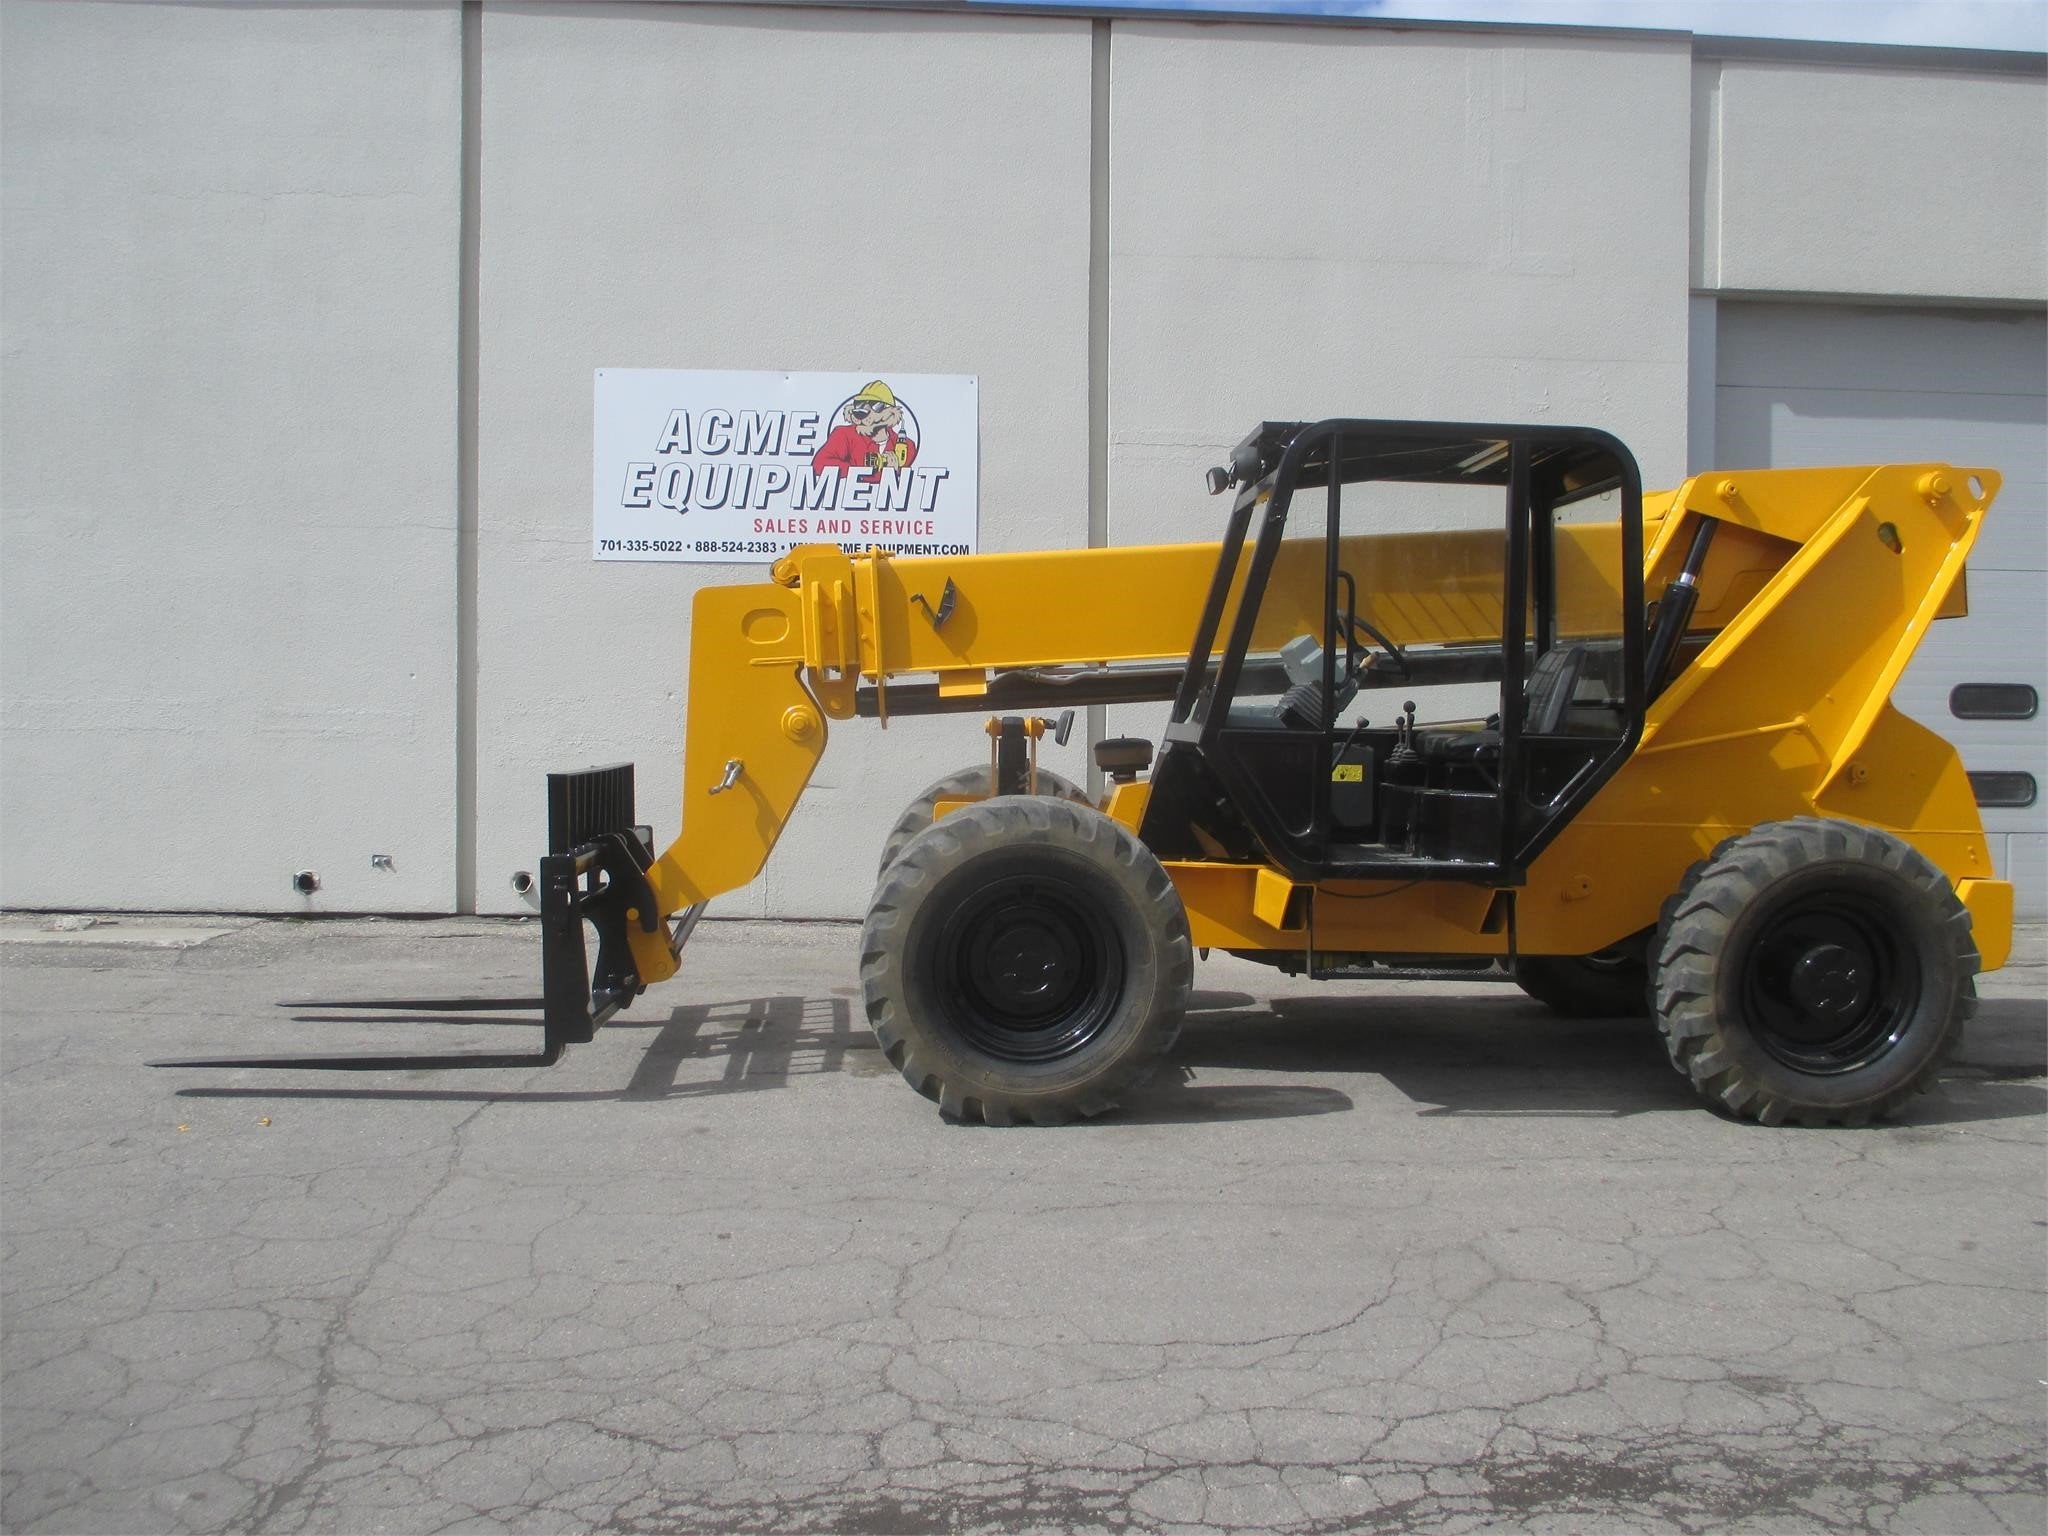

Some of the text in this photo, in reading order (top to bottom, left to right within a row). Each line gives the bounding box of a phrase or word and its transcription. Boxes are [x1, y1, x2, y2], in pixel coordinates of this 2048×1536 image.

[655, 408, 819, 456] ACME
[621, 461, 949, 514] EQUIPMENT
[753, 518, 934, 535] SALES AND SERVICE
[600, 540, 682, 551] 701-335-5022
[695, 541, 777, 553] 888-524-2383
